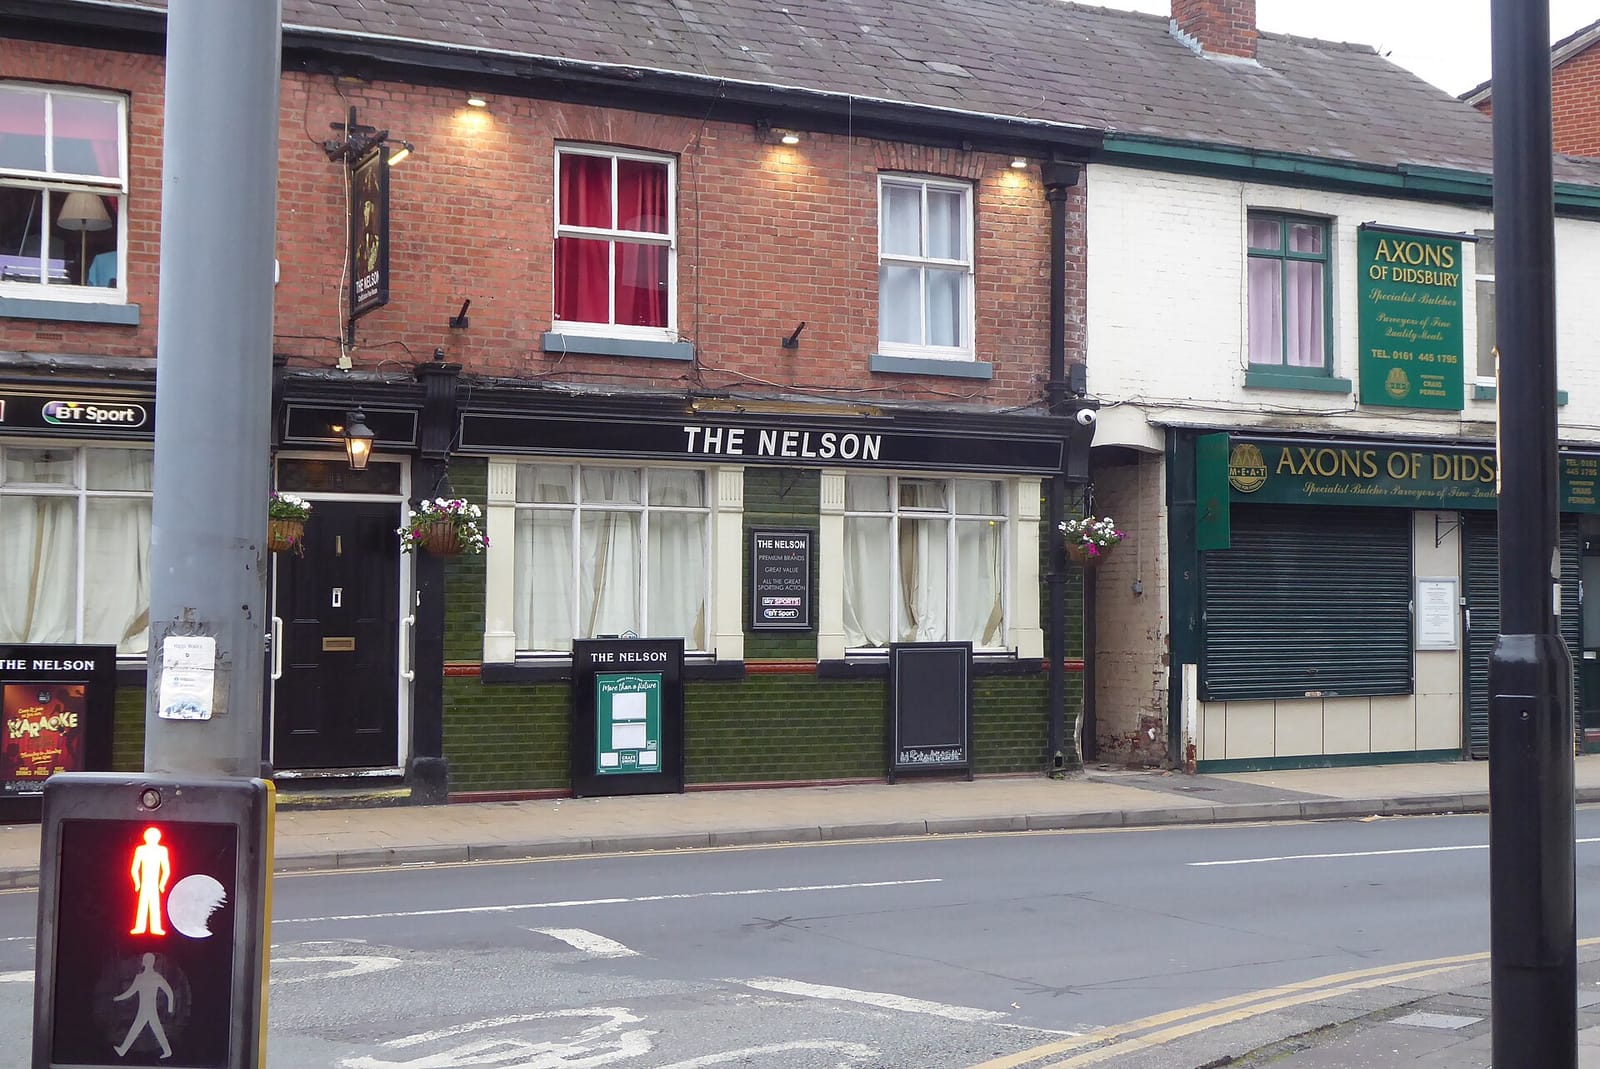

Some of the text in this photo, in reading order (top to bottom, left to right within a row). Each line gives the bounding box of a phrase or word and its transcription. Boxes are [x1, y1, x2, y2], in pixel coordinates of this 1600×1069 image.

[1374, 239, 1454, 268] AXONS
[1370, 264, 1459, 288] OF DIDSBURY
[356, 278, 364, 294] THE
[1368, 288, 1457, 306] Specialist Butcher
[1384, 328, 1417, 343] Quality
[1371, 349, 1390, 359] TEL.
[1392, 350, 1414, 360] 0161
[1418, 352, 1434, 362] 445
[56, 406, 134, 422] BT Sport
[684, 426, 882, 460] THE NELSON
[1276, 447, 1495, 483] AXONS OF DIDS
[1302, 482, 1350, 496] Specialist
[1350, 484, 1388, 495] Butcher
[758, 540, 806, 549] THE NELSON
[0, 660, 95, 670] THE NELSON
[591, 652, 667, 662] THE NELSON
[602, 684, 618, 692] More
[618, 683, 632, 692] than
[8, 712, 78, 738] KARAOKE
